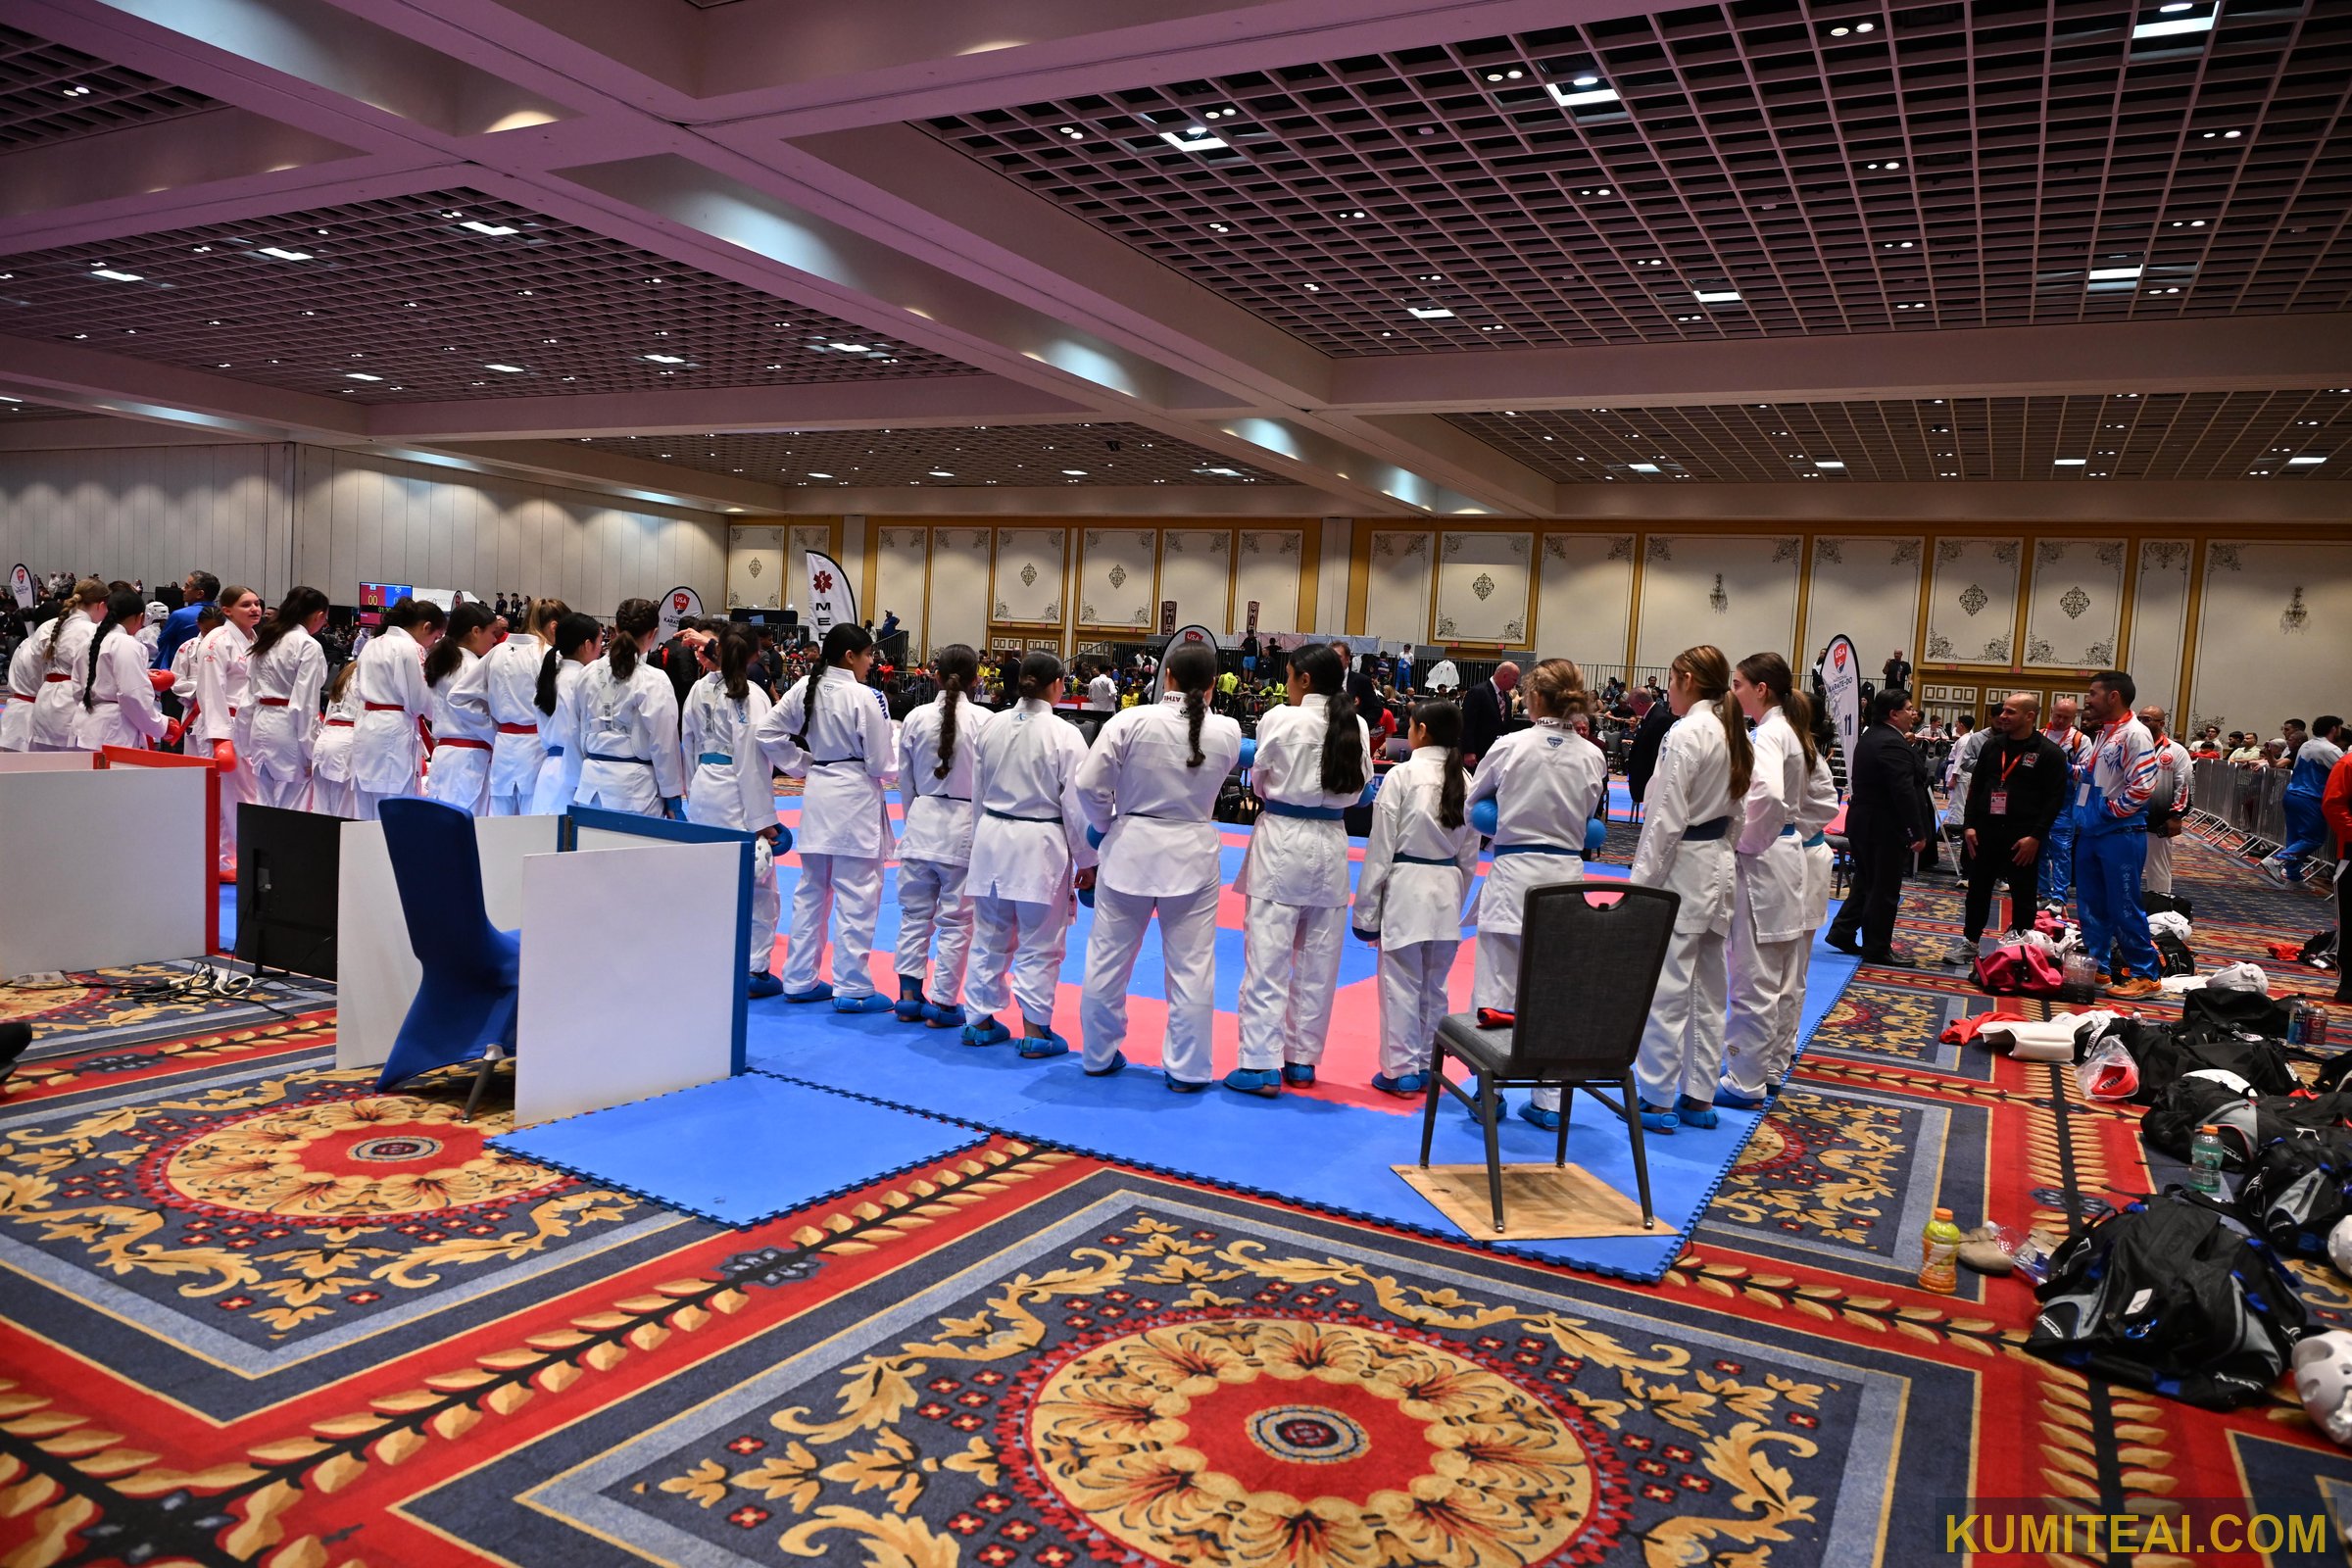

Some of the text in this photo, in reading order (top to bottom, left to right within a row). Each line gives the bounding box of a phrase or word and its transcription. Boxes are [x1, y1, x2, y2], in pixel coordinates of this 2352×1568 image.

[675, 595, 687, 605] USA
[1187, 632, 1200, 641] USA
[1835, 648, 1846, 659] USA
[1844, 713, 1852, 736] 11
